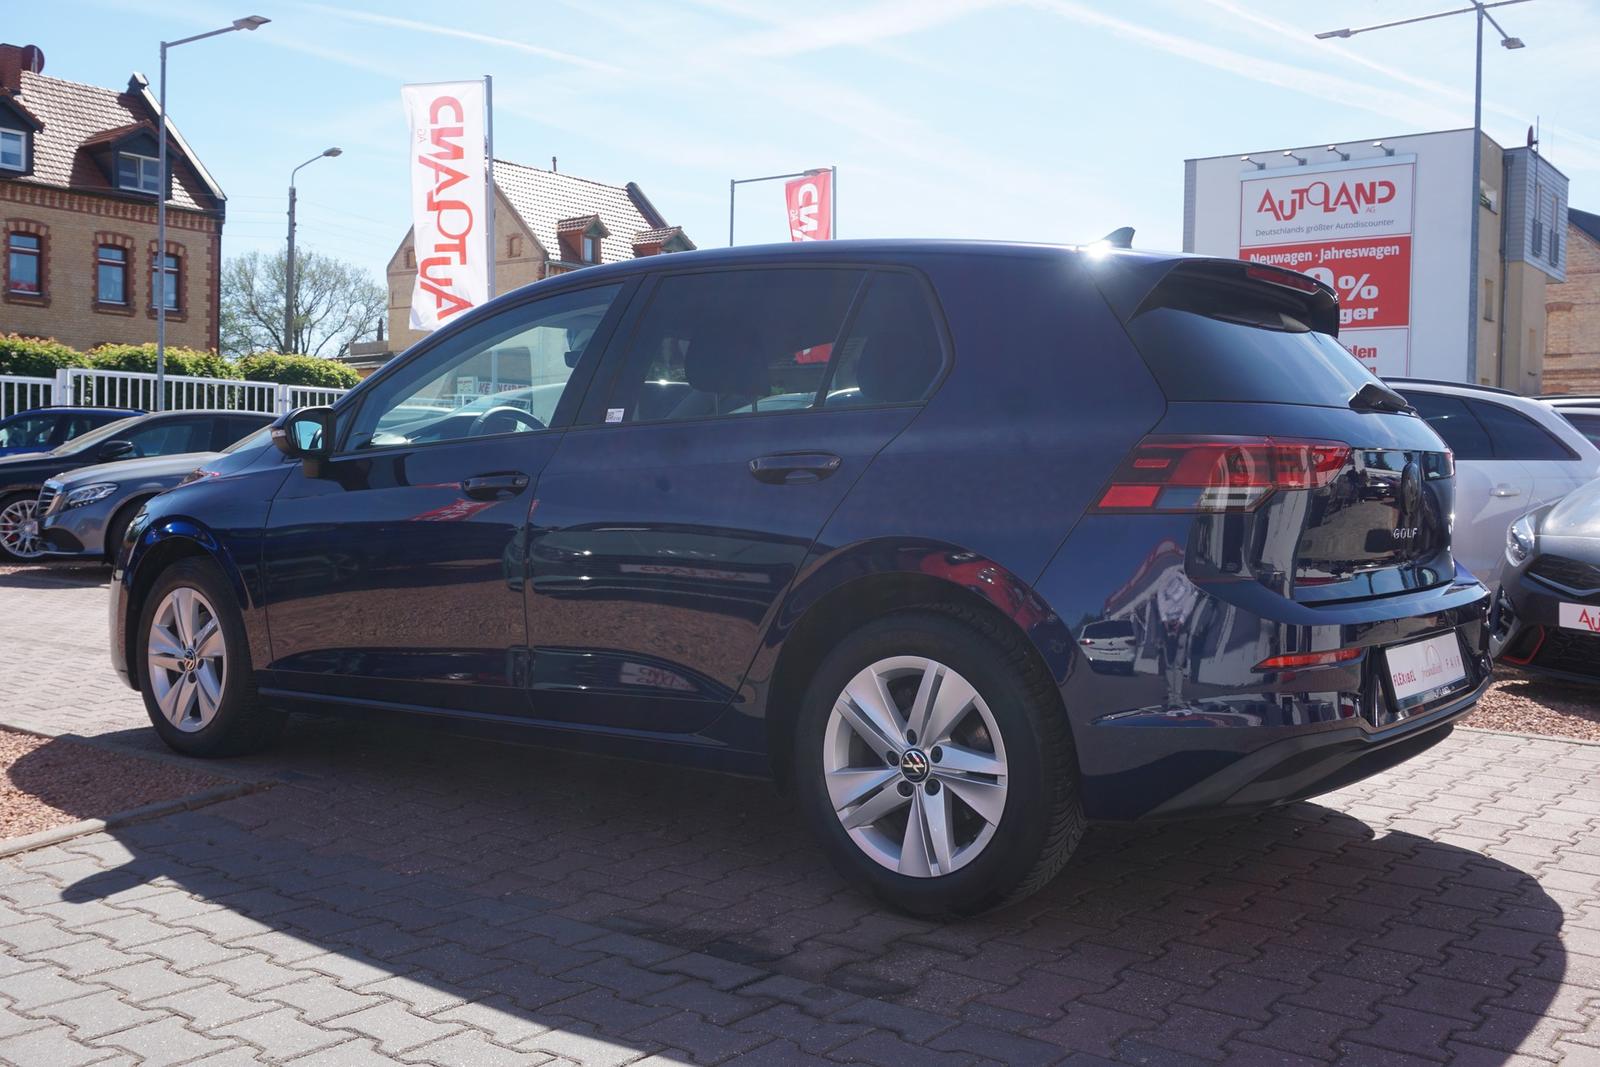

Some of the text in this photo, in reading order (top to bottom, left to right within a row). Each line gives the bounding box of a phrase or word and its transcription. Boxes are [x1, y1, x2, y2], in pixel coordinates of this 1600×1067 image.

[1257, 180, 1396, 221] AUTOLAND
[1255, 219, 1395, 237] Deutschlands größter Autodiscounter
[1250, 245, 1400, 266] Neuwagen Jahreswagen
[1393, 527, 1418, 540] GOLF
[1579, 608, 1600, 632] AU
